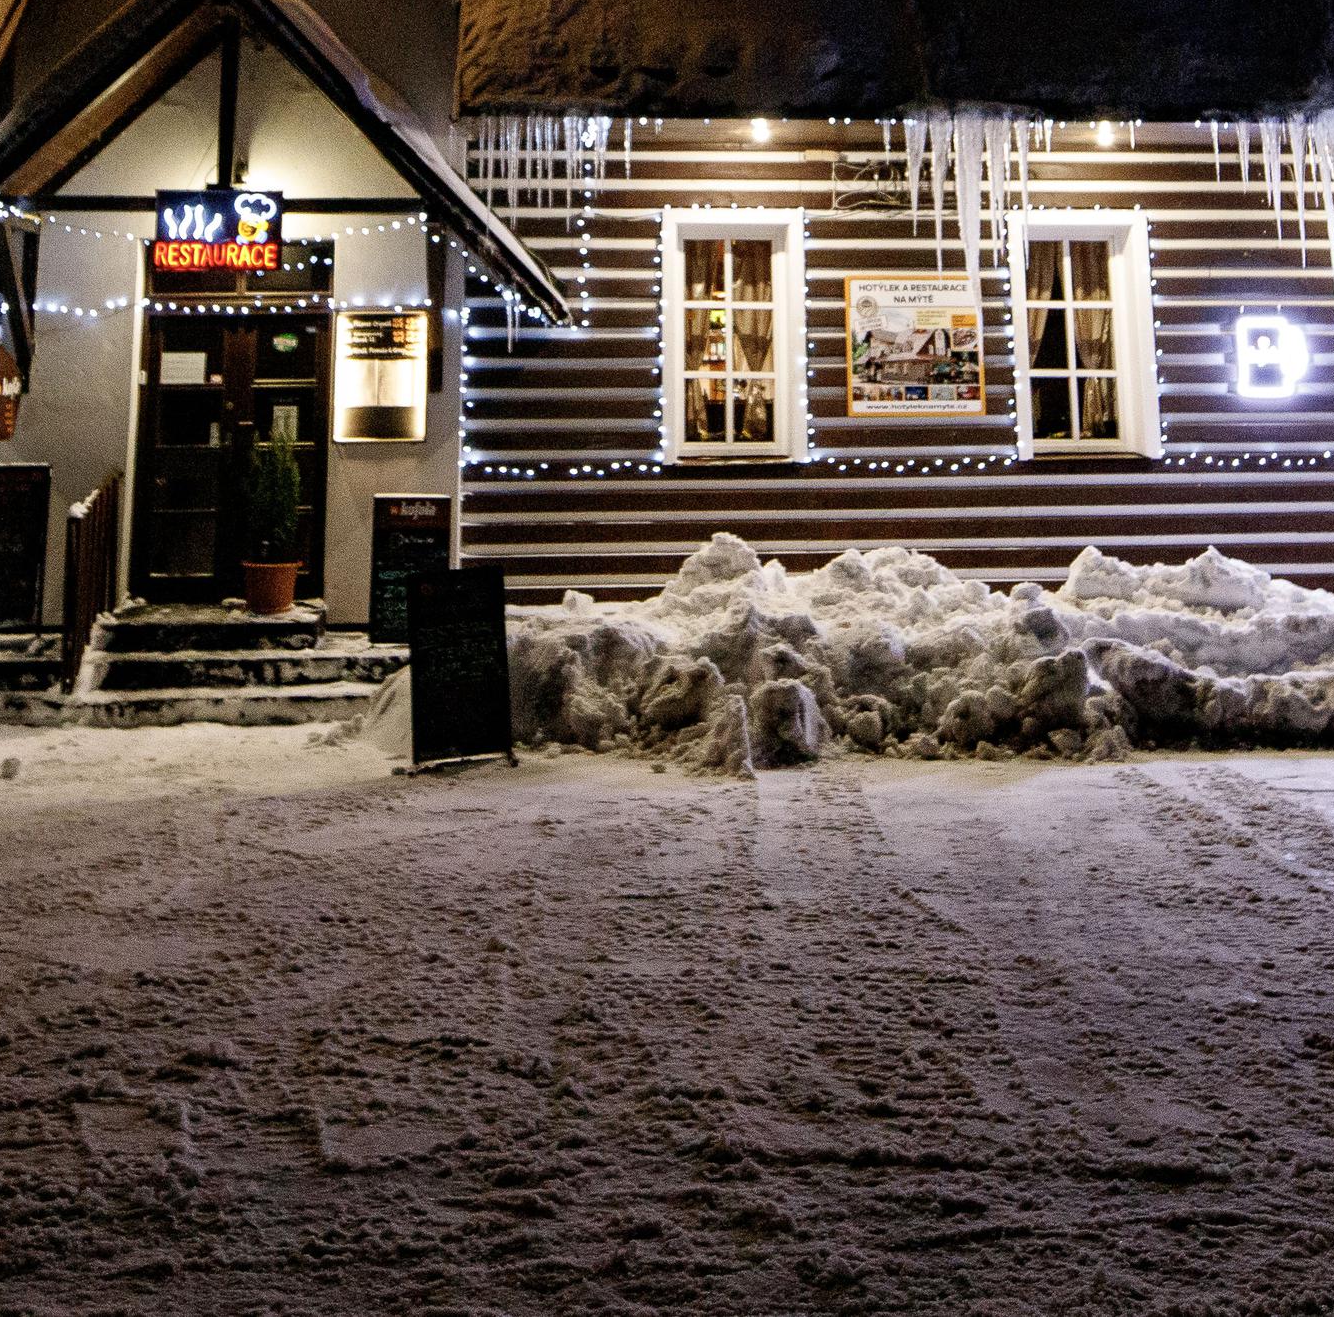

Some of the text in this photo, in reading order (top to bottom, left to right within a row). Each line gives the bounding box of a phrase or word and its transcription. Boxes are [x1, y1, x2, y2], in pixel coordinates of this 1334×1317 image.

[153, 241, 278, 269] RESTAURACE
[910, 283, 968, 292] RESTAURACE
[893, 295, 906, 303] NA
